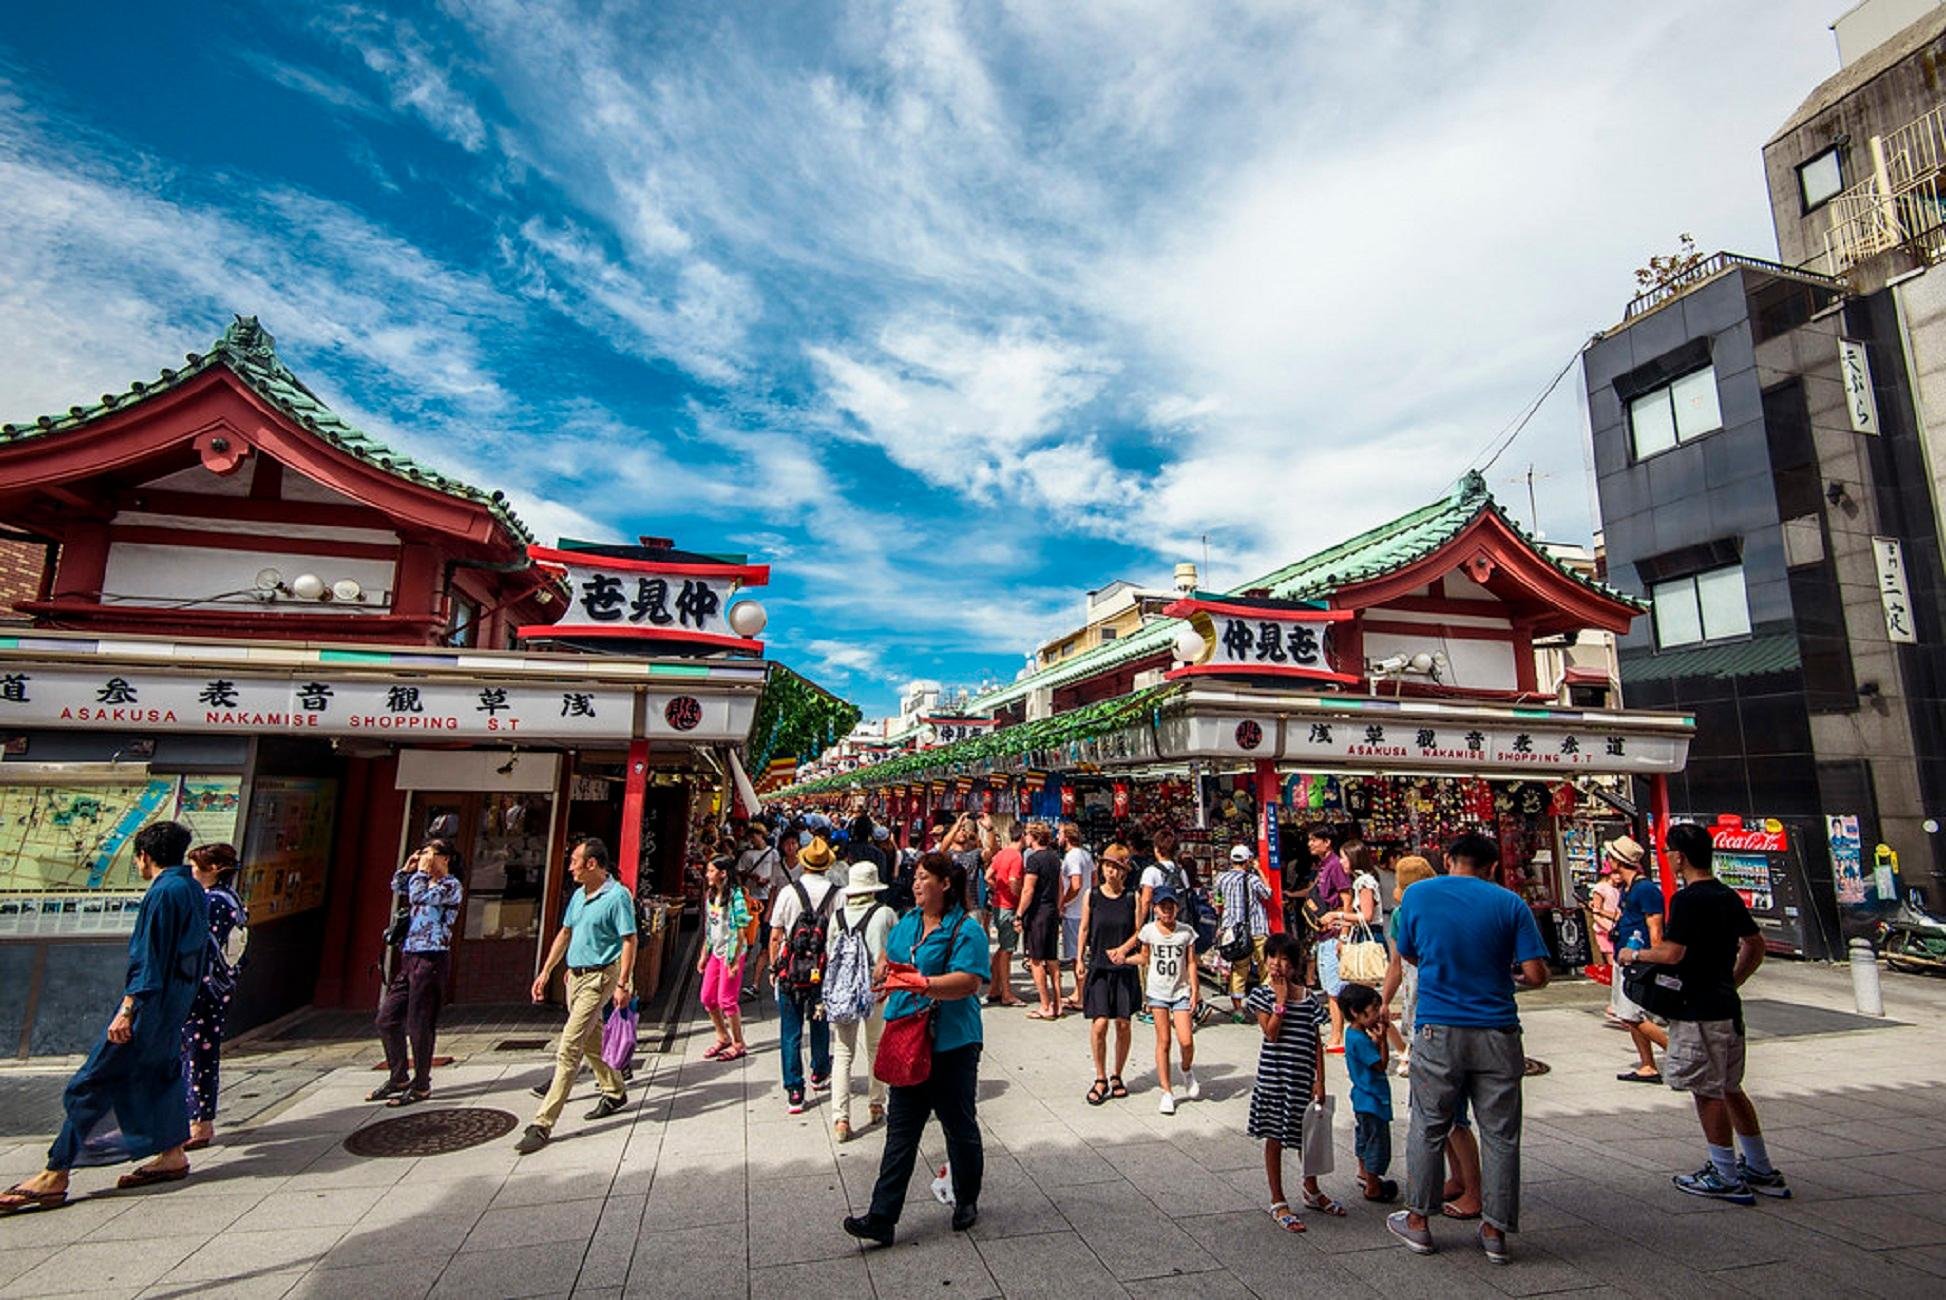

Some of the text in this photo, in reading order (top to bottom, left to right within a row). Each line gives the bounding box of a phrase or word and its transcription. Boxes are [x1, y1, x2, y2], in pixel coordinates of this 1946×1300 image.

[1222, 618, 1319, 664] 仲見世
[60, 706, 178, 723] ASAKUSA
[206, 711, 319, 727] NAKAMISE
[350, 714, 458, 730] SHOPPING
[1347, 744, 1408, 757] ASAKUSA
[1422, 748, 1486, 761] NAKAMISE
[1497, 752, 1560, 763] SHOPPING
[1157, 960, 1177, 976] GO
